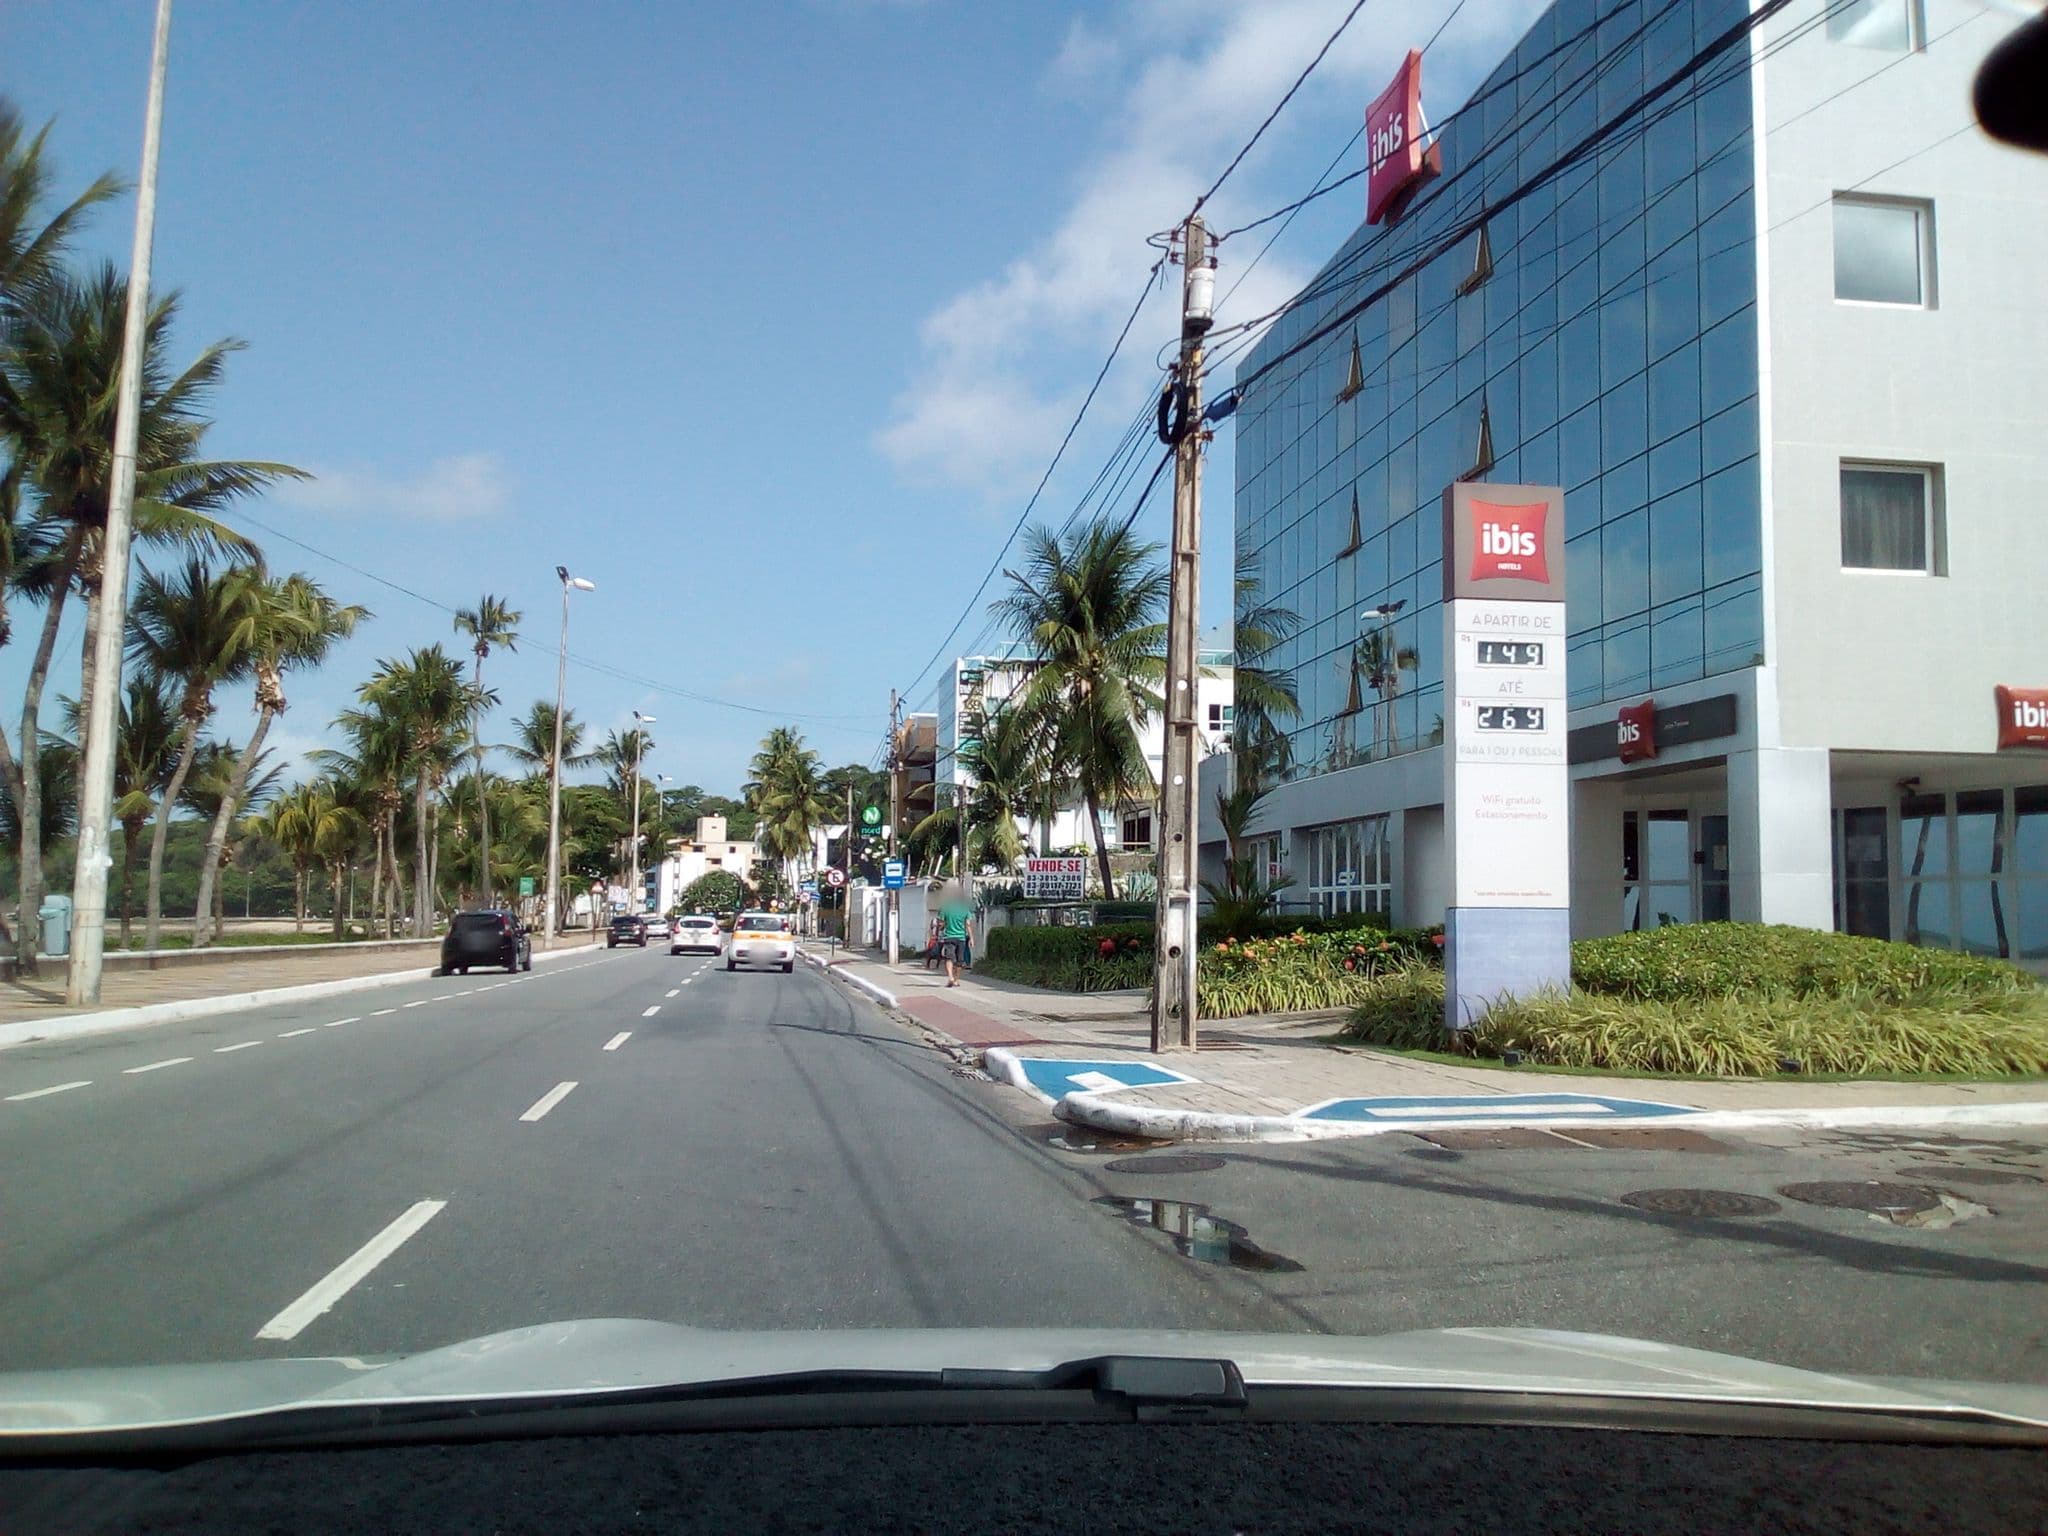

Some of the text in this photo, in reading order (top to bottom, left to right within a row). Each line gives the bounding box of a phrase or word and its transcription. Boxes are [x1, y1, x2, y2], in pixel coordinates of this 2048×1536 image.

[1373, 112, 1403, 176] ibis
[1482, 523, 1536, 556] ibis
[1472, 614, 1552, 629] A PARTIR DE
[1486, 644, 1540, 666] 149
[1498, 678, 1524, 694] ATÉ
[1479, 707, 1541, 730] 269
[2014, 700, 2048, 728] ibi
[1617, 719, 1640, 745] ibis
[1493, 746, 1509, 756] OU
[1028, 860, 1081, 872] VENDE-SE
